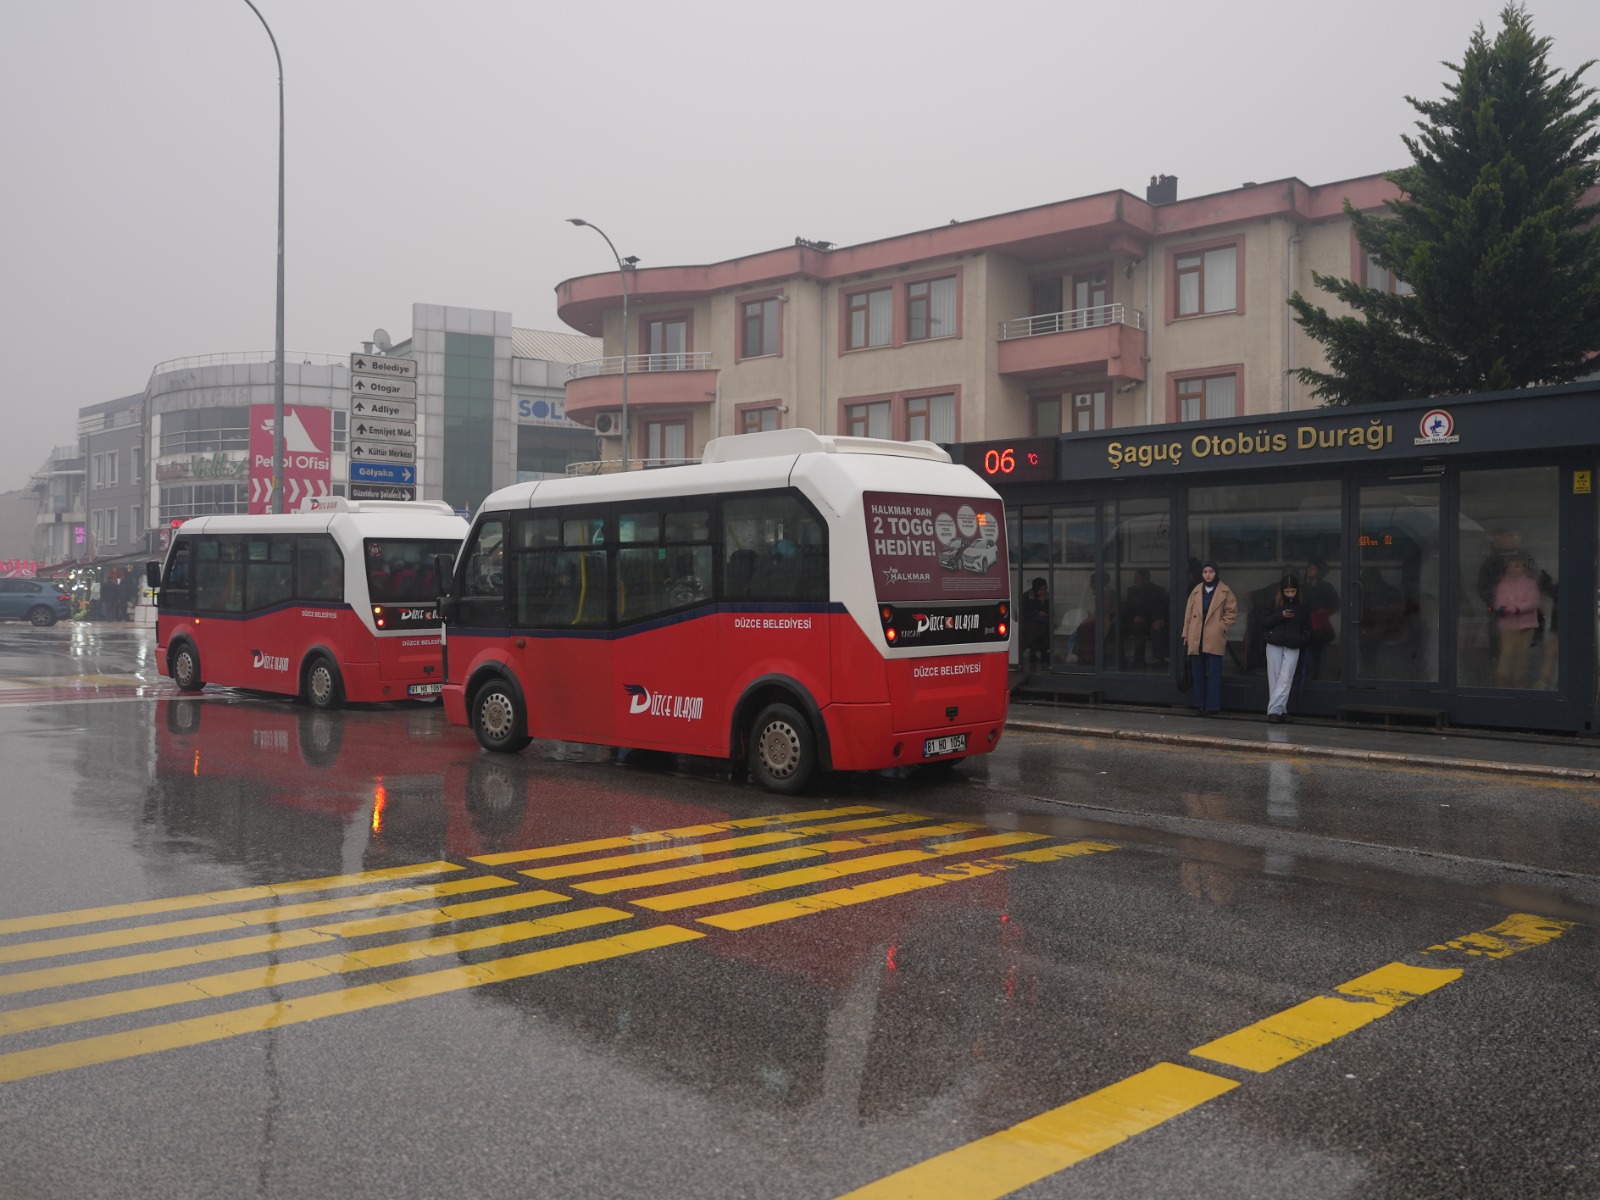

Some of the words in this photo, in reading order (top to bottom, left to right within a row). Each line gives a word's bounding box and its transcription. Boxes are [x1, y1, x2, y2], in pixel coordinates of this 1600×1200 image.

[372, 361, 409, 373] Belediye
[371, 383, 400, 393] Otogar
[371, 404, 399, 415] Adliye
[369, 426, 396, 436] Emniyet
[399, 428, 413, 437] Müd.
[1107, 442, 1182, 469] Şaguç
[1191, 429, 1287, 458] Otobüs
[1297, 419, 1393, 450] Durağı
[368, 448, 387, 456] Kültür
[389, 449, 412, 458] Merkezi
[296, 455, 330, 470] Ofisi
[985, 448, 1015, 474] 06
[359, 467, 394, 477] Gölyaka
[871, 504, 912, 515] HALKMAR
[873, 516, 883, 534] 2
[888, 517, 934, 536] TOGG
[875, 536, 937, 557] HEDİYE!
[891, 573, 931, 581] HALKMAR
[735, 616, 761, 628] DÜZCE
[763, 617, 812, 629] BELEDİYESİ
[913, 666, 939, 678] DÜZCE
[940, 662, 982, 676] BELEDİYESİ
[623, 683, 672, 716] DÜZCE
[927, 741, 935, 753] 81
[950, 735, 965, 748] 1054
